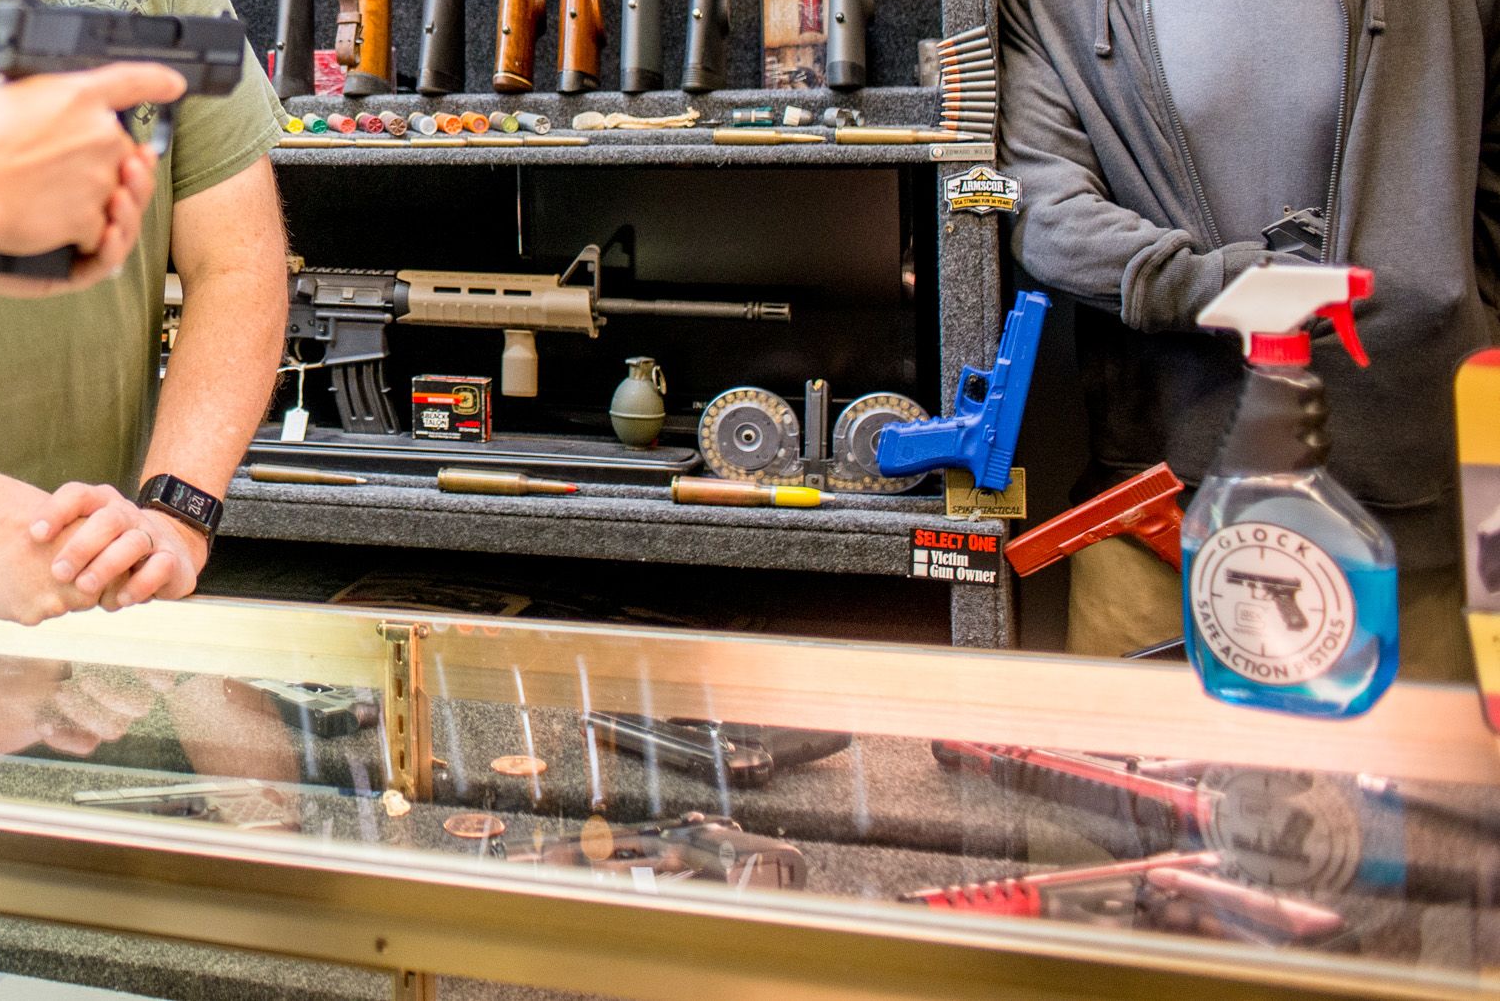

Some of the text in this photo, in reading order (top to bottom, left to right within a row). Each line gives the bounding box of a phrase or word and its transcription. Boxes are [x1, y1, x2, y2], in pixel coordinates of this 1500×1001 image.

[961, 180, 1005, 193] ARMSCOR
[914, 529, 997, 553] SELECT ONE
[1217, 527, 1312, 559] GLOCK
[930, 550, 969, 567] Victim
[930, 564, 997, 583] Gun Owner
[1197, 599, 1290, 679] SAFE-ACTION
